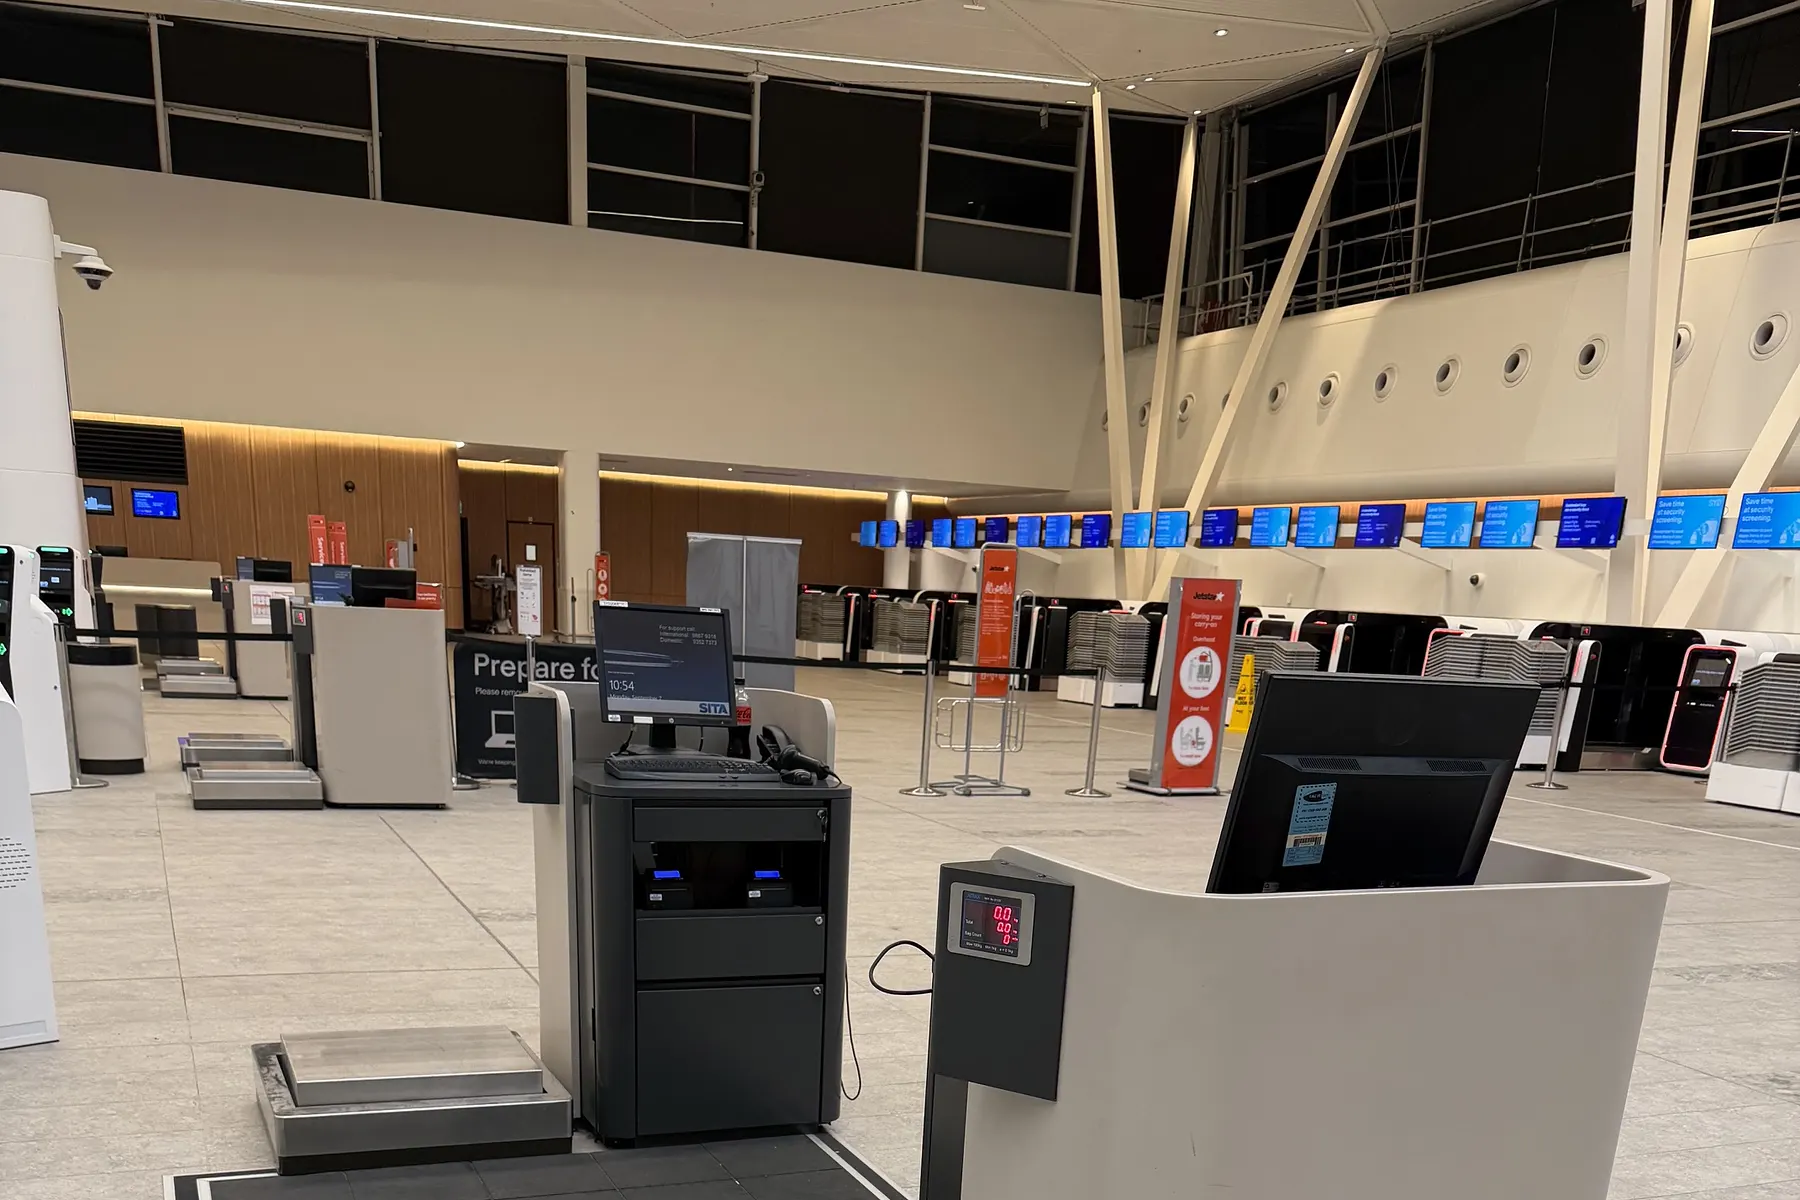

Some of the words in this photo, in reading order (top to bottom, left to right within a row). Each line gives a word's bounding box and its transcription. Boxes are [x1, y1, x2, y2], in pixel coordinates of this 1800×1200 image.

[1751, 506, 1774, 514] security
[473, 652, 576, 683] Prepare
[581, 656, 600, 681] fo
[609, 680, 635, 690] 10:54
[475, 687, 500, 696] Please
[698, 702, 728, 715] SITA
[993, 905, 1012, 921] 0.0
[996, 921, 1012, 933] 0.0
[1003, 934, 1011, 945] 0
